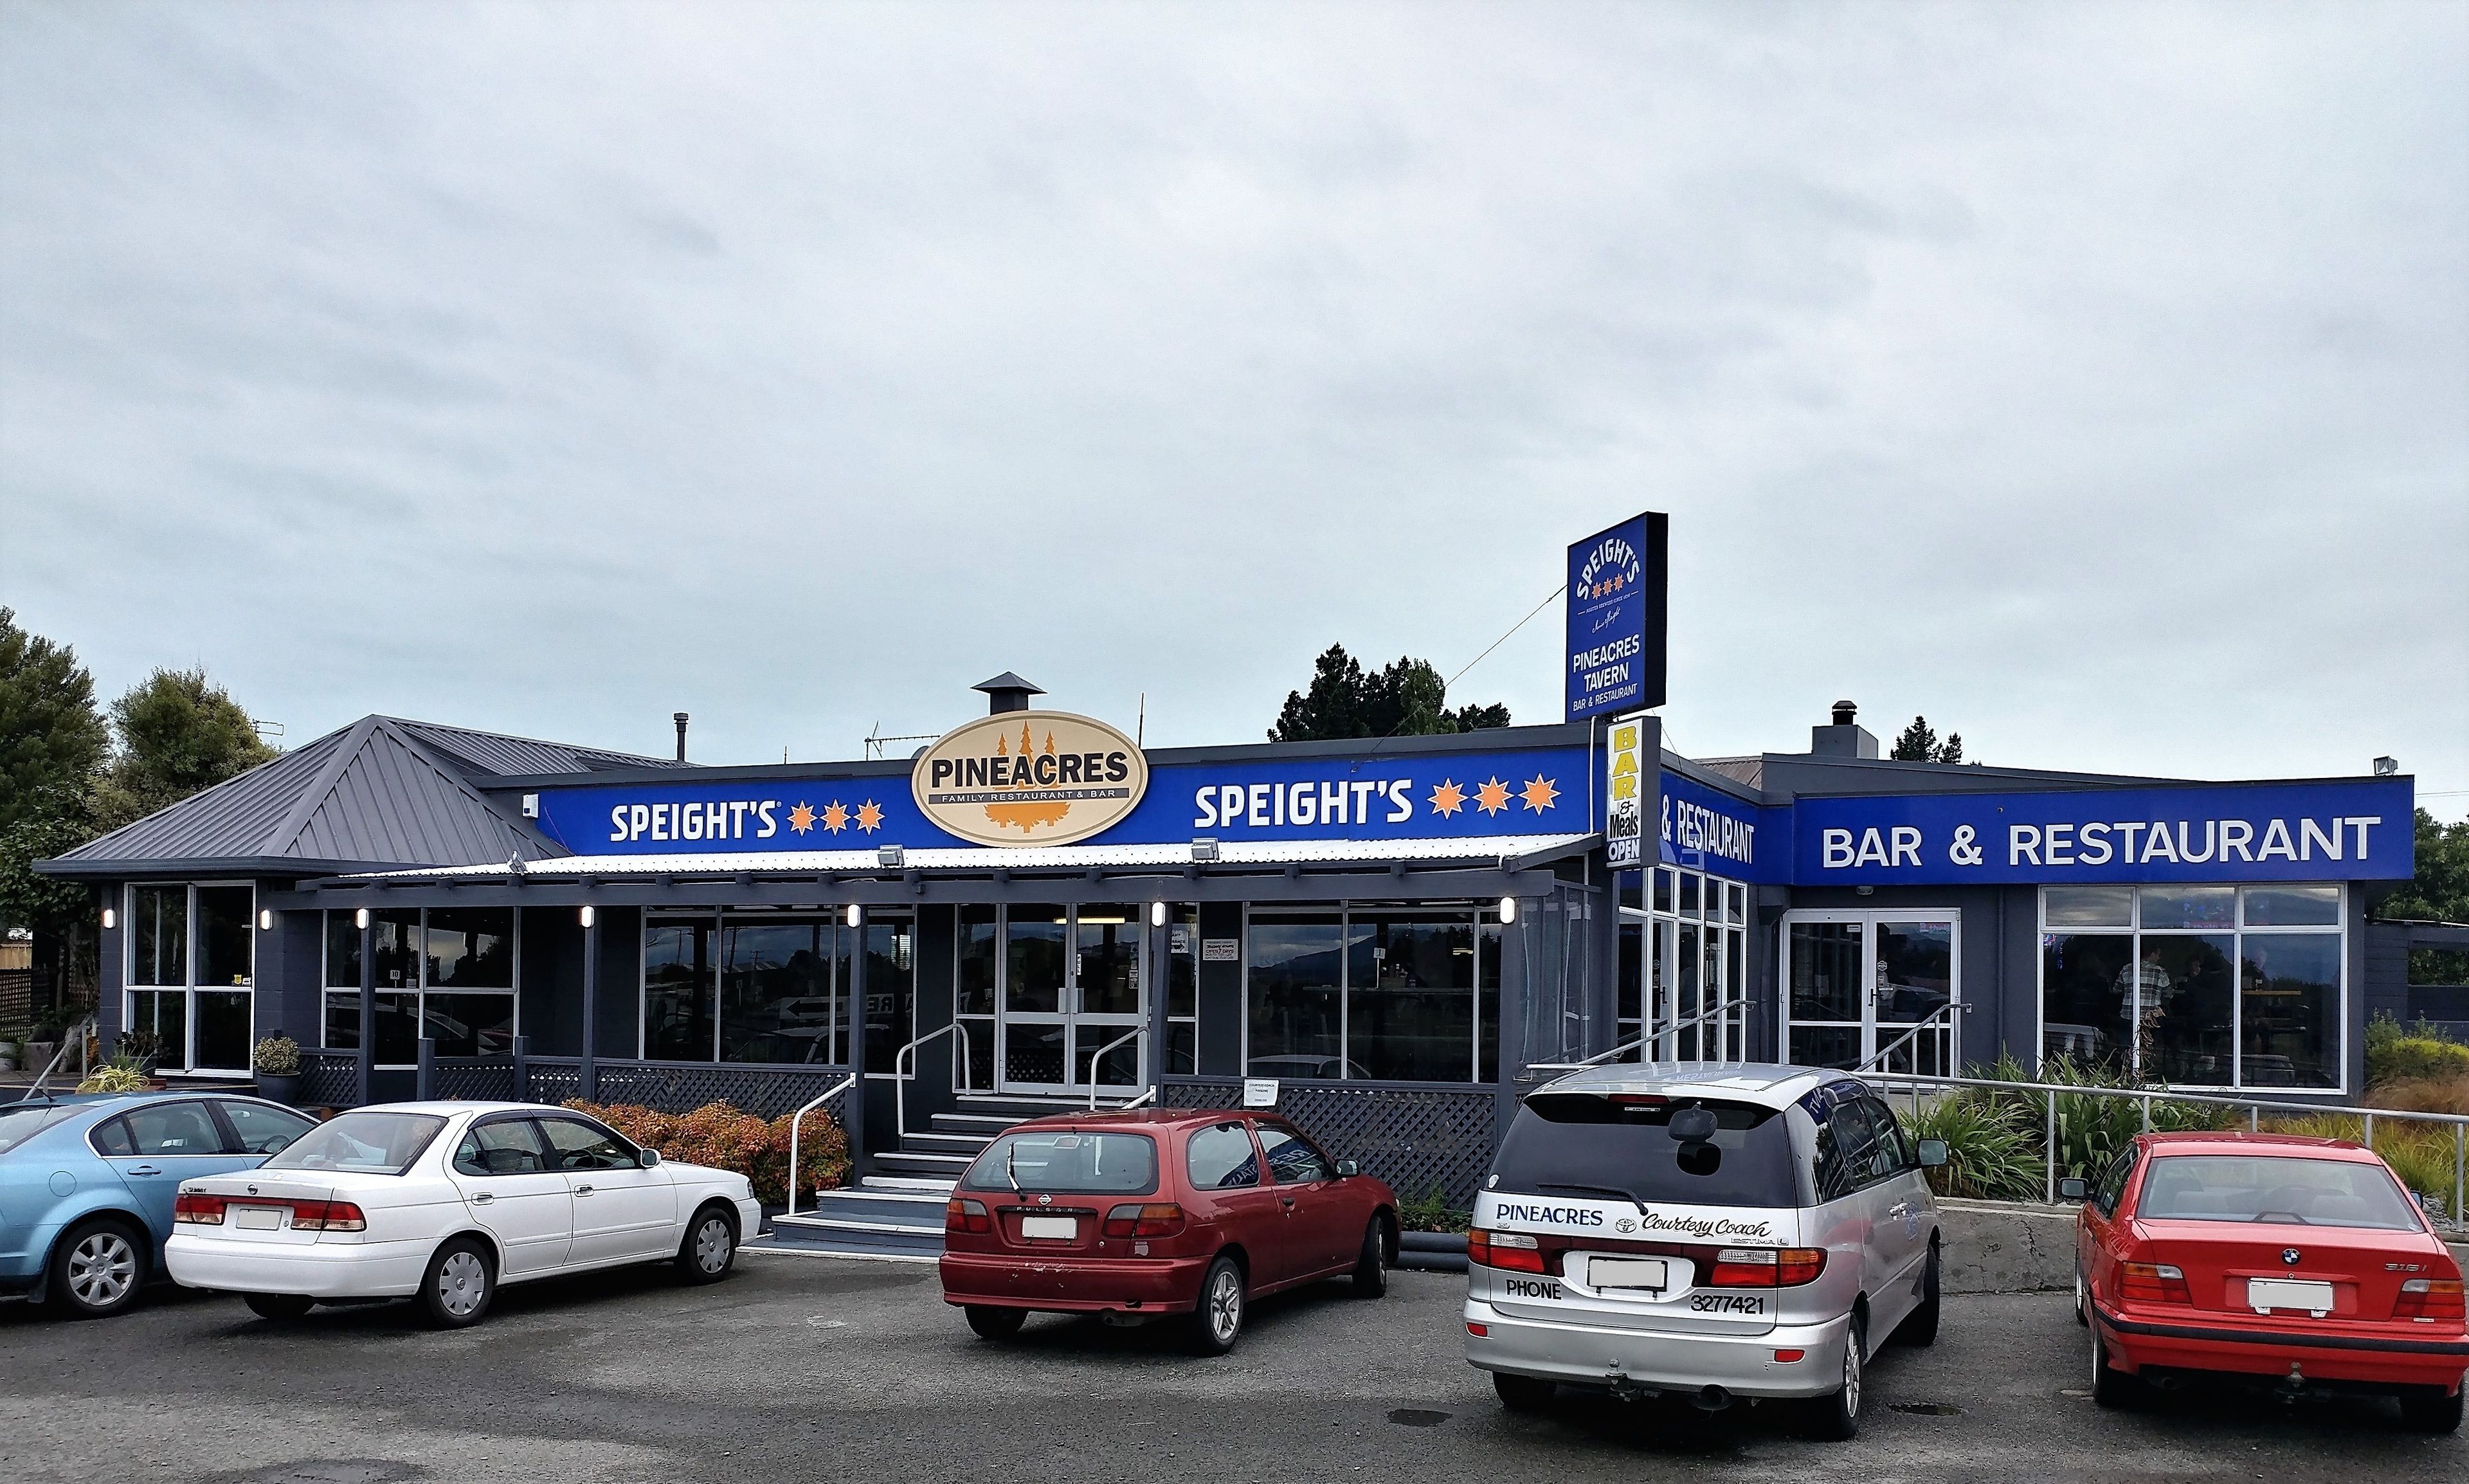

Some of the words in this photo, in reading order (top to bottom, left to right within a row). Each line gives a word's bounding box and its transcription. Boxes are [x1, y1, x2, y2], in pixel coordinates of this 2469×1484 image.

[1577, 538, 1640, 600] SPEIGHT'S
[1573, 634, 1640, 673] PINEACRES
[1584, 662, 1629, 692] TAVERN
[1573, 696, 1586, 712] BAR
[1588, 695, 1593, 707] &
[1595, 683, 1638, 705] RESTAURANT
[932, 751, 1128, 788] PINEACRES
[1612, 725, 1639, 801] BAR
[942, 794, 985, 802] FAMILY
[991, 791, 1073, 801] RESTAURANT
[1090, 789, 1116, 799] BAR
[1194, 779, 1413, 828] SPEIGHT'S
[1620, 801, 1634, 815] &
[610, 800, 777, 842] SPEIGHT'S
[1609, 811, 1638, 838] Meals
[1661, 794, 1671, 842] &
[1678, 799, 1755, 864] RESTAURANT
[1608, 838, 1640, 861] OPEN
[1822, 827, 1922, 868] BAR
[1948, 824, 1983, 866] &
[2009, 816, 2381, 867] RESTAURANT
[1496, 1204, 1603, 1226] PINEACRES
[1642, 1213, 1714, 1238] Courtesy
[1715, 1219, 1772, 1237] Coach
[1506, 1280, 1562, 1300] PHONE
[1690, 1294, 1764, 1315] 3277421
